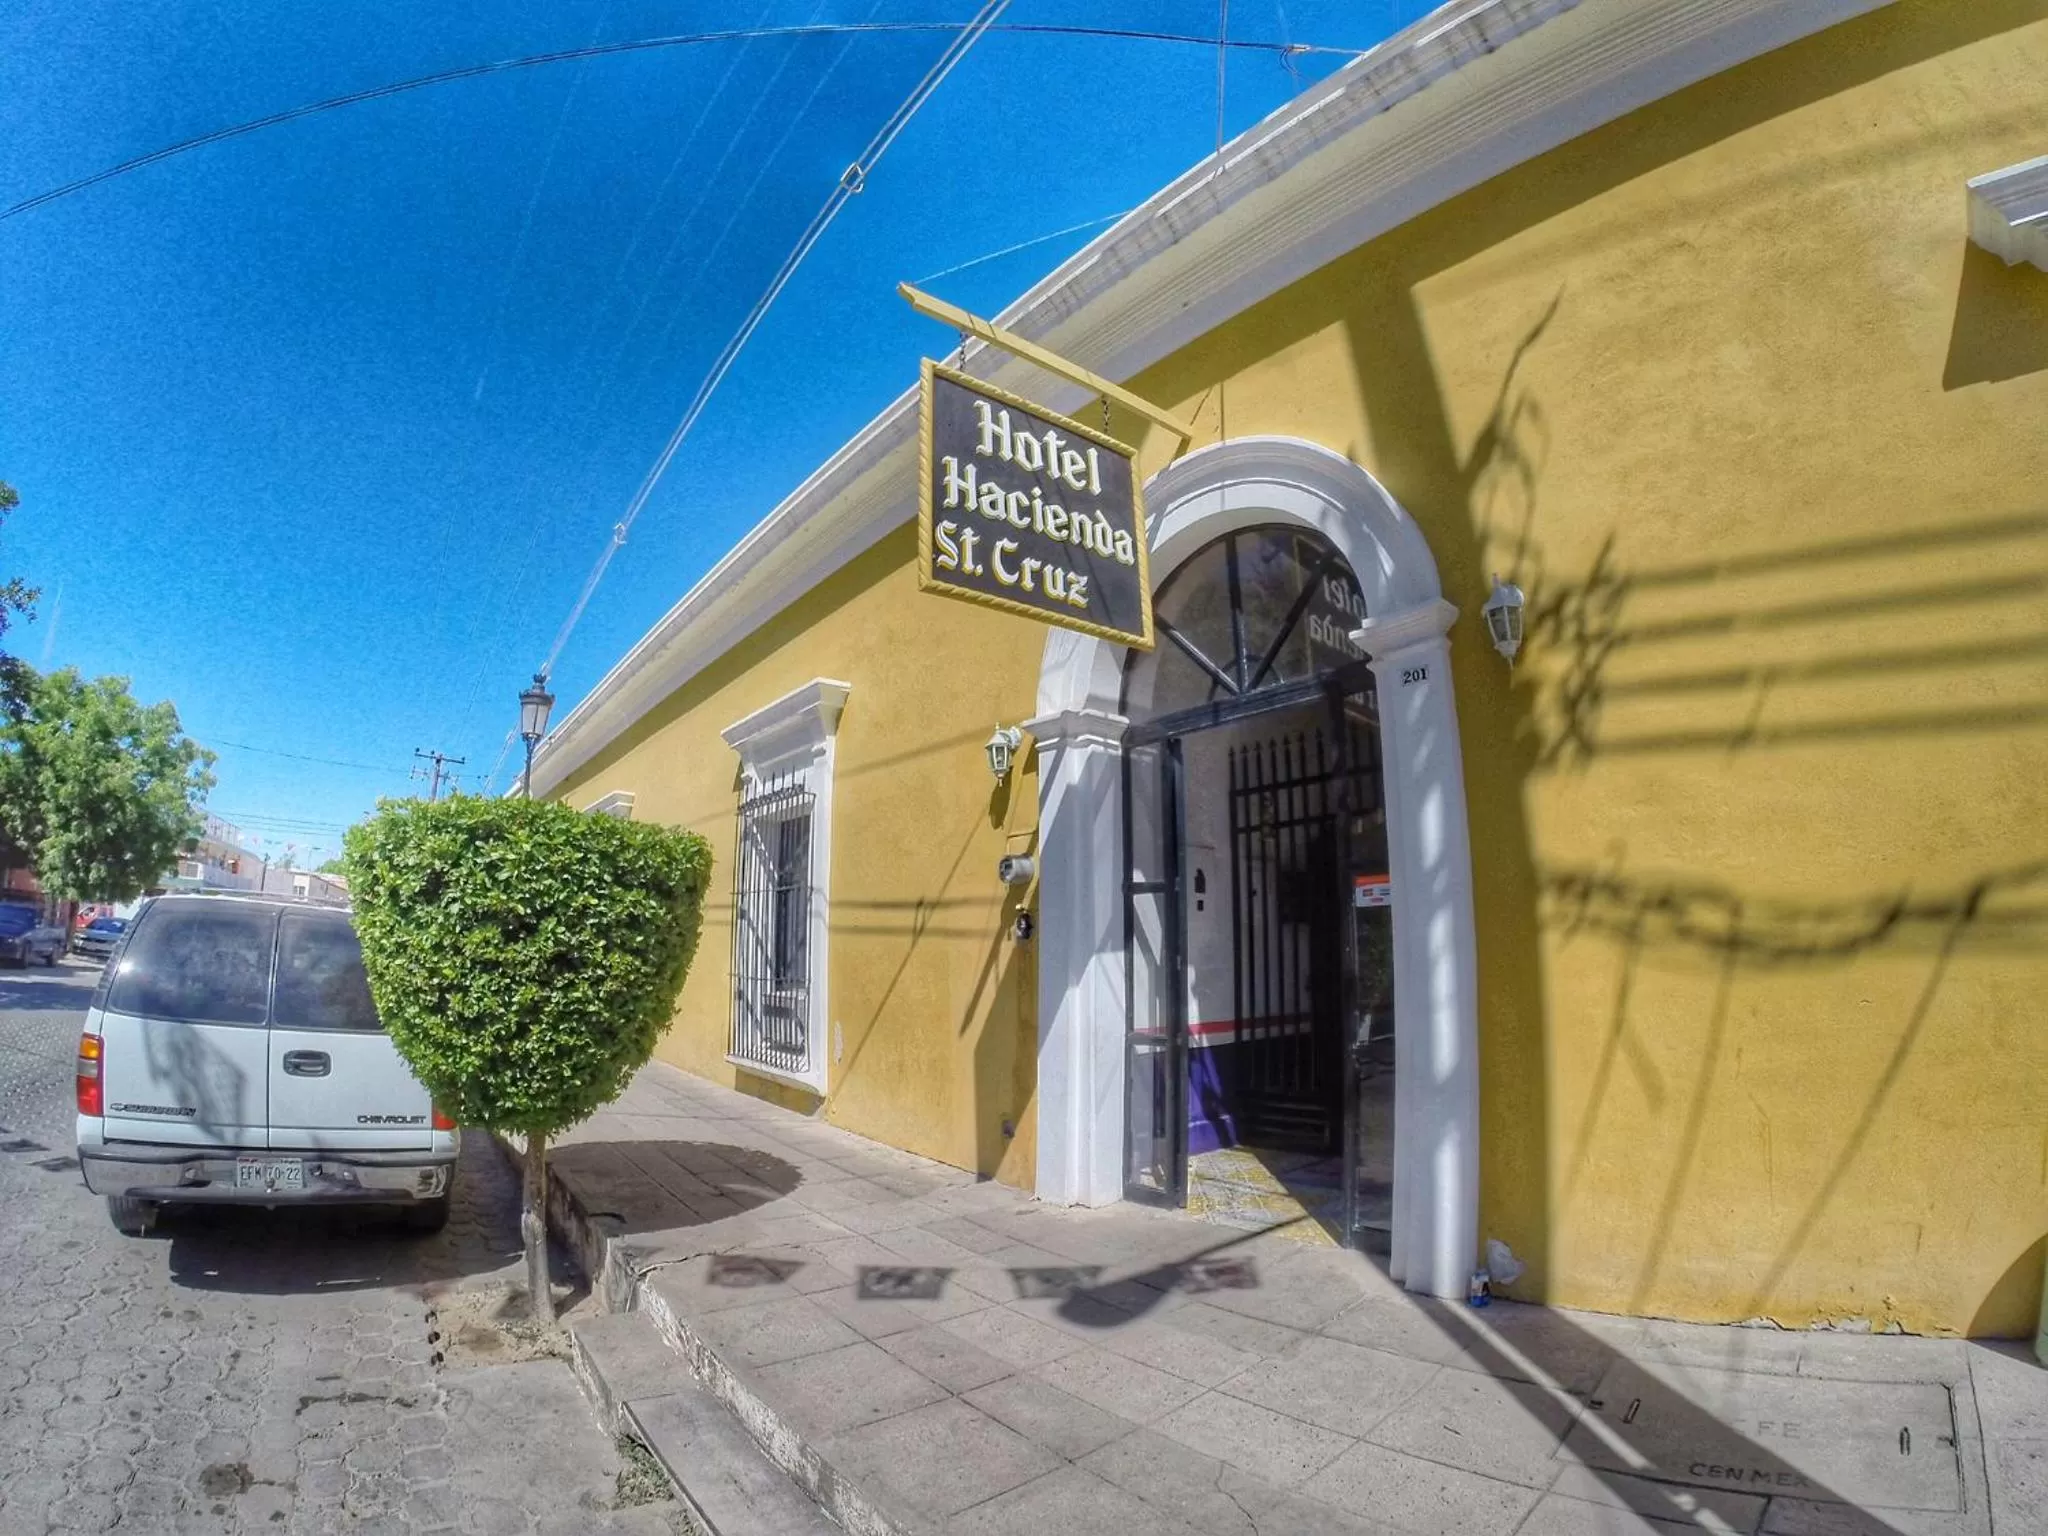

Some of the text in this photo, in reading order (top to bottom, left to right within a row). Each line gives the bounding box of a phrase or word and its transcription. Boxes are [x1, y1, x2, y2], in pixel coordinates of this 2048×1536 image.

[973, 400, 1101, 496] Hotel
[941, 455, 1135, 566] Hacienda
[934, 520, 1089, 609] St. Cruz
[1402, 667, 1427, 684] 201
[357, 1114, 427, 1125] CHEVROLET
